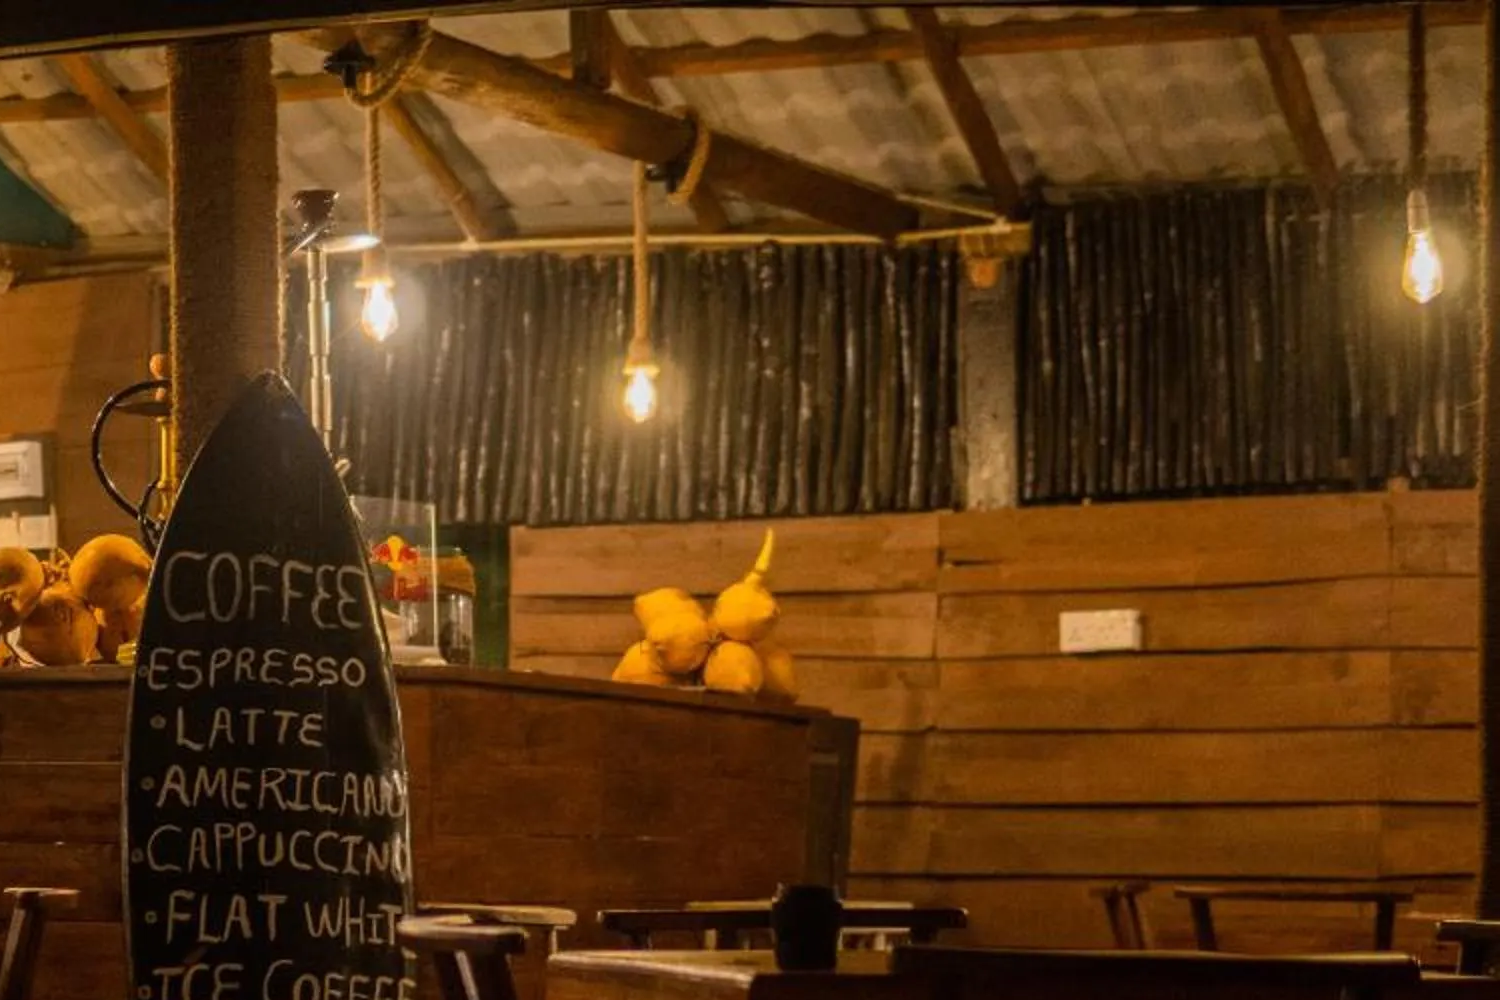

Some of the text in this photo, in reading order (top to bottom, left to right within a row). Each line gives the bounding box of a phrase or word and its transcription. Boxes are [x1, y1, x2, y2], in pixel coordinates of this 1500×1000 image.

[163, 551, 366, 628] COFFEE
[147, 648, 366, 690] ESPRESSO
[176, 706, 324, 750] LATTE
[156, 764, 406, 818] AMERICANO
[147, 822, 411, 884] CAPPUCCINO
[166, 889, 404, 947] FLAT WHIT
